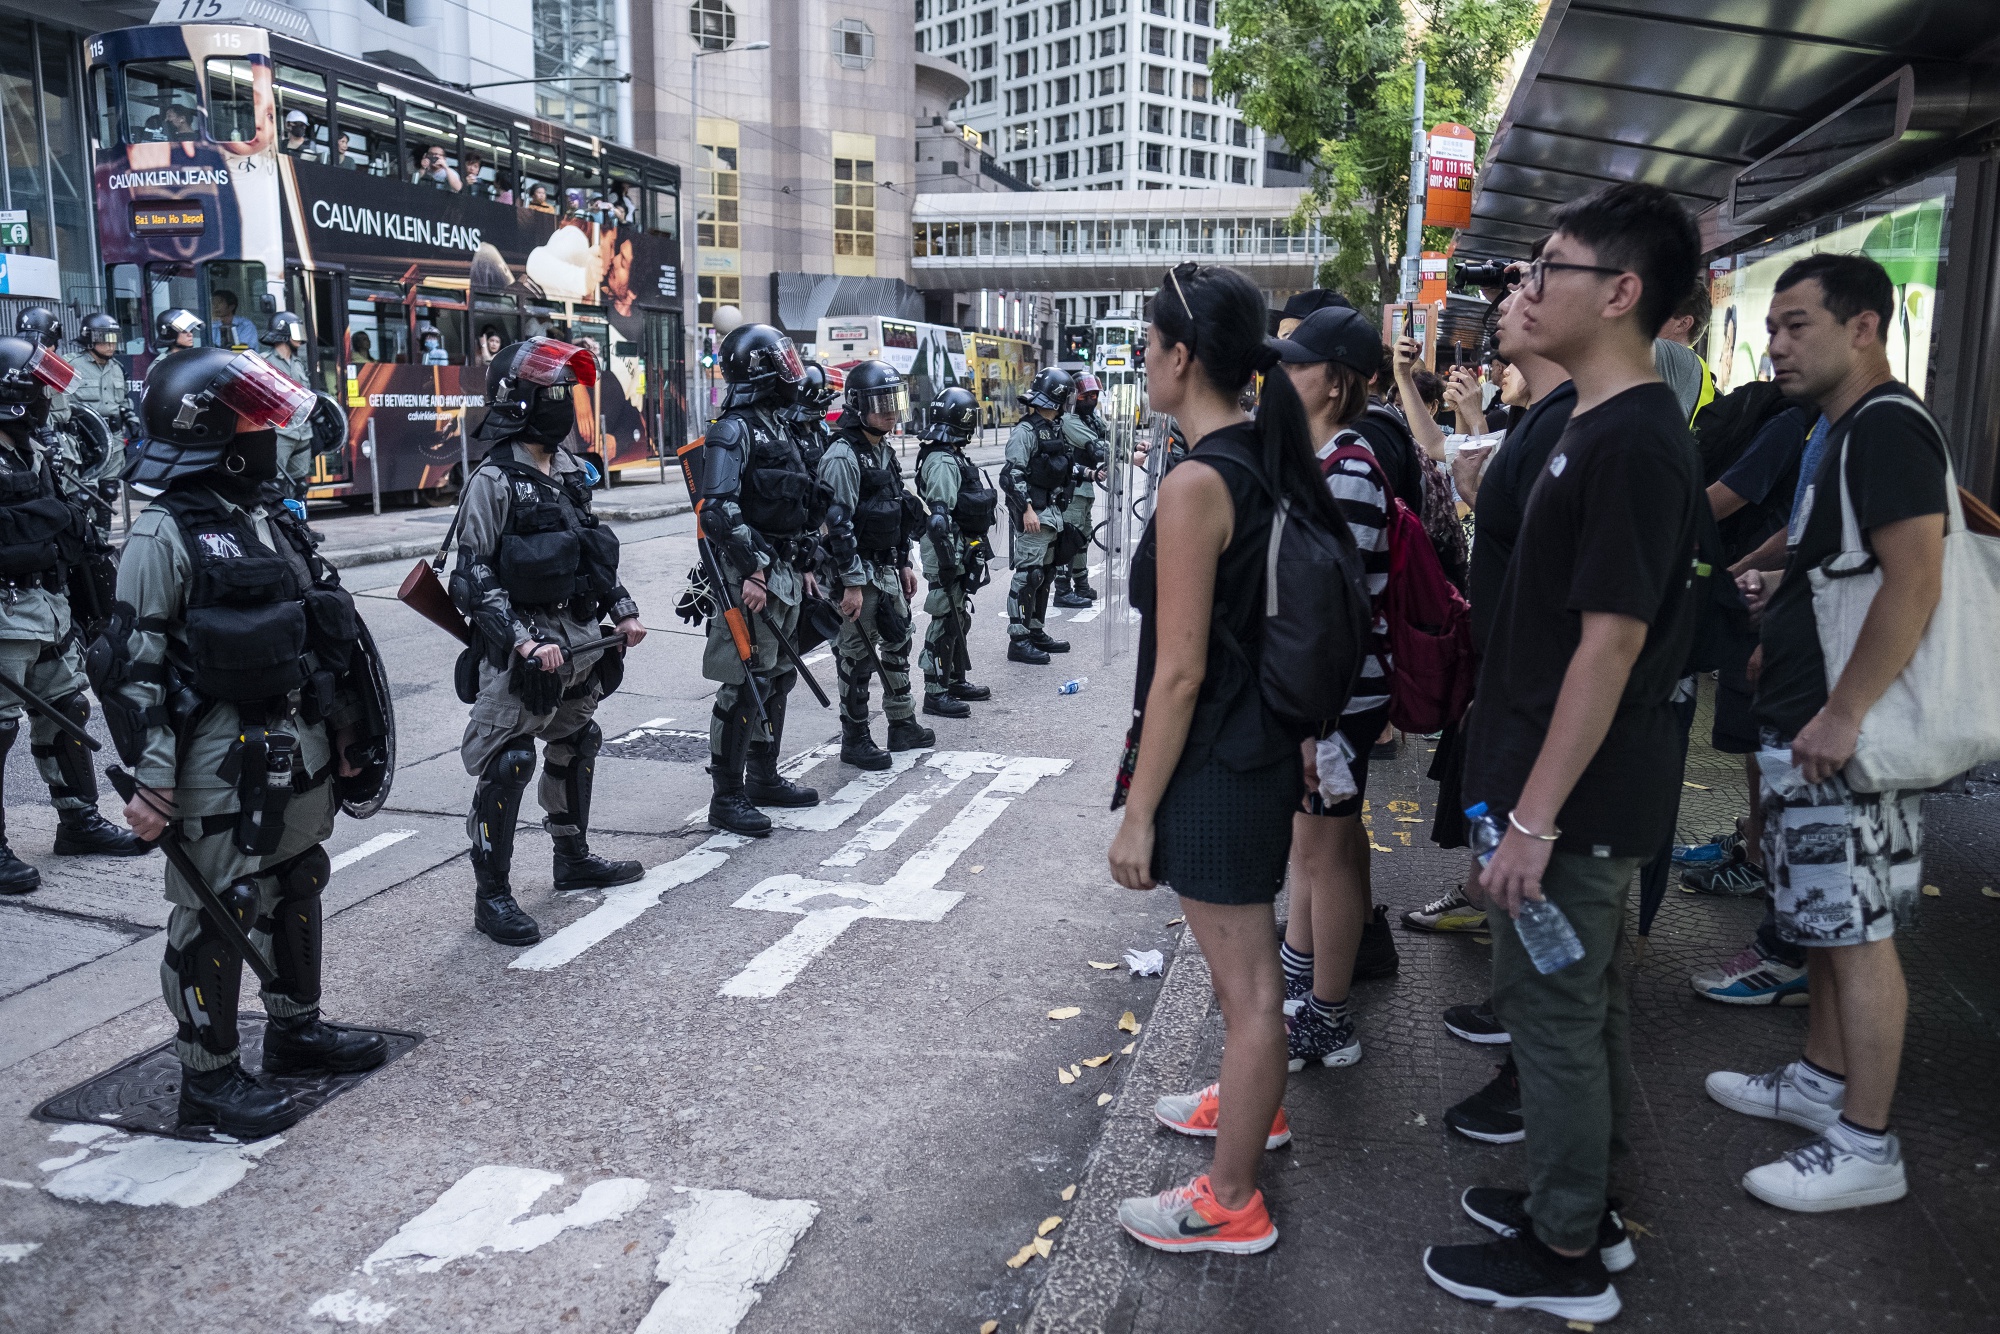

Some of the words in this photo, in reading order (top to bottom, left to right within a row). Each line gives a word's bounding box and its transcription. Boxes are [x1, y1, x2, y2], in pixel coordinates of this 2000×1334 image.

[178, 0, 222, 20] 115
[213, 33, 241, 48] 115
[90, 41, 104, 58] 115
[1432, 159, 1443, 171] 101
[1446, 161, 1457, 173] 111
[1460, 162, 1472, 175] 115
[109, 173, 143, 189] CALVIN
[145, 170, 180, 186] KLEIN
[181, 169, 229, 185] JEANS
[1444, 176, 1456, 189] 641
[135, 215, 148, 225] Sai
[152, 215, 166, 224] Wan
[169, 214, 179, 224] Ho
[182, 213, 204, 224] Depot
[312, 200, 382, 237] CALVIN
[384, 212, 431, 244] KLEIN
[432, 221, 481, 252] JEANS
[369, 393, 384, 407] GET
[384, 394, 418, 407] BETWEEN
[418, 394, 430, 407] ME
[430, 394, 445, 407] AND
[445, 394, 485, 407] #MYCALVINS
[408, 410, 452, 421] calvinklein.com
[683, 459, 692, 479] LETHAL
[1804, 915, 1819, 923] LAS
[1824, 913, 1851, 922] VEGAS
